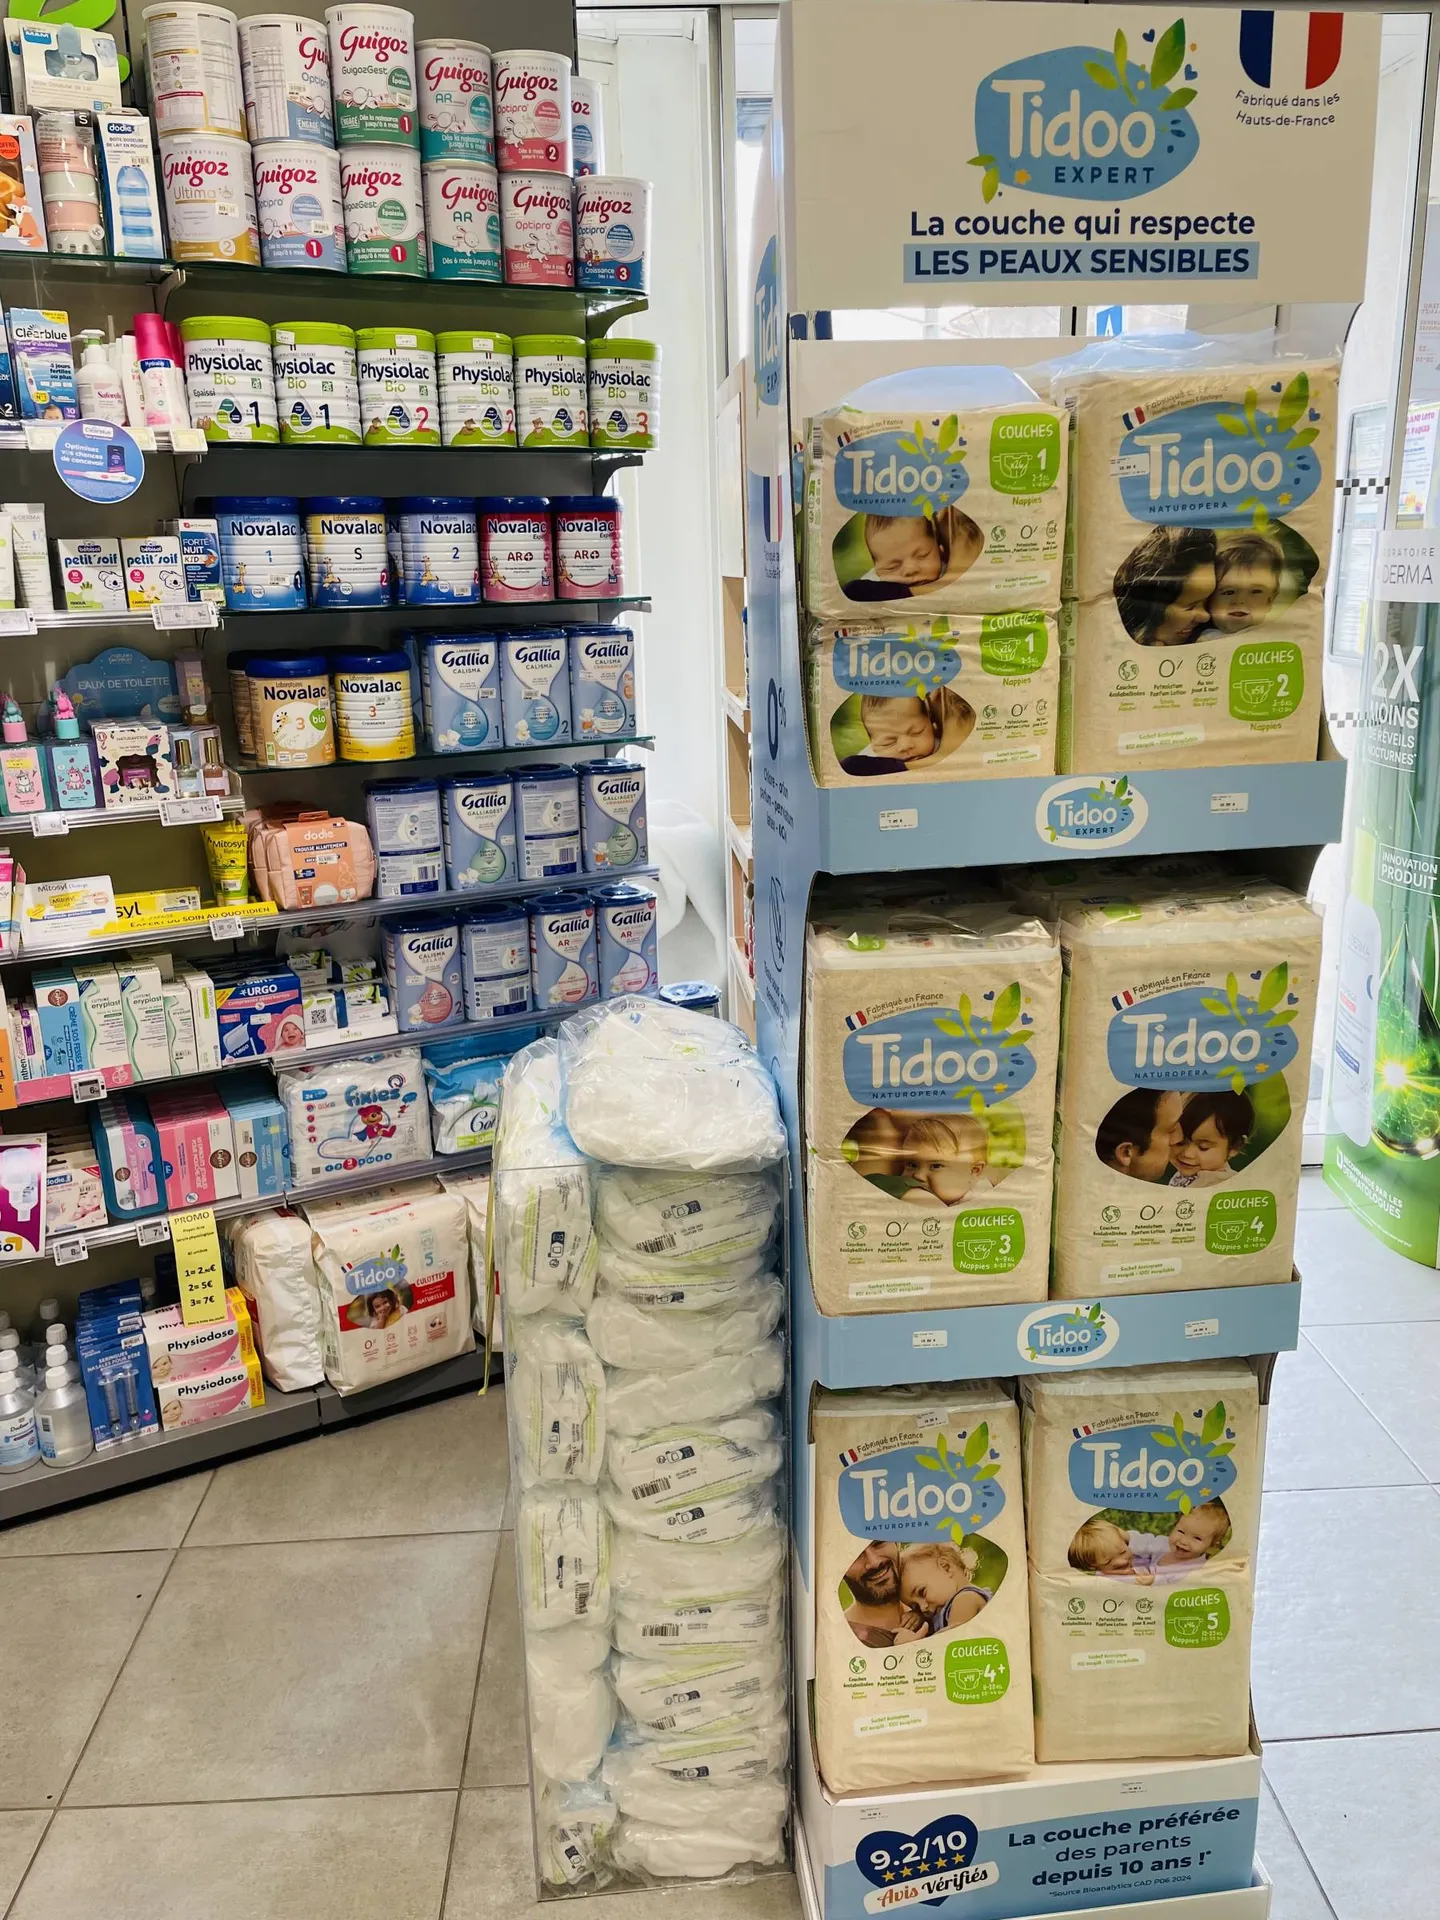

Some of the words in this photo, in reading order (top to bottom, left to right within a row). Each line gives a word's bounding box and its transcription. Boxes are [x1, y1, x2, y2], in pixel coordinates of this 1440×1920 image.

[340, 26, 408, 62] Guigoz
[342, 66, 387, 77] GuigozGest
[425, 57, 488, 92] Guigoz
[496, 71, 558, 100] Guigoz
[435, 93, 452, 103] AR
[1235, 89, 1289, 108] Fabriqué
[1291, 95, 1320, 107] dans
[1322, 93, 1341, 105] les
[992, 79, 1156, 159] Tidoo
[1236, 110, 1336, 127] Hauts-de-France
[109, 124, 131, 132] dodie
[163, 153, 229, 186] Guigoz
[254, 162, 318, 194] Guigoz
[1054, 166, 1156, 185] EXPERT
[174, 187, 216, 200] Ultima
[514, 187, 570, 218] Guigoz
[576, 193, 632, 222] Guigoz
[453, 211, 473, 222] AR
[910, 210, 945, 236] La
[953, 208, 1066, 237] couche
[1074, 208, 1121, 242] qui
[1130, 212, 1256, 242] respecte
[516, 221, 553, 231] Optipro
[914, 249, 971, 275] LES
[980, 249, 1083, 275] PEAUX
[1090, 247, 1251, 274] SENSIBLES
[15, 326, 68, 341] Clearblue
[189, 353, 263, 375] Physiolac
[361, 362, 429, 382] Physiolac
[214, 372, 236, 386] Bio
[287, 377, 307, 389] Bio
[452, 366, 514, 385] Physiolac
[525, 368, 586, 386] Physiolac
[590, 370, 651, 387] Physiolac
[385, 380, 406, 393] Bio
[480, 384, 499, 396] Bio
[552, 385, 570, 397] Bio
[608, 387, 627, 399] Bio
[999, 424, 1054, 439] COUCHES
[65, 442, 99, 452] Optimisez
[75, 450, 103, 460] chances
[71, 457, 105, 466] concevoir
[1037, 448, 1047, 471] 1
[1133, 432, 1284, 500] Tidoo
[843, 450, 943, 496] Tidoo
[1148, 501, 1229, 514] NATUROPERA
[231, 521, 297, 537] Novalac
[321, 519, 383, 535] Novalac
[420, 519, 478, 534] Novalac
[487, 519, 547, 534] Novalac
[557, 518, 614, 533] Novalac
[183, 546, 204, 554] NUIT
[353, 547, 363, 560] S
[989, 612, 1038, 632] COUCHES
[584, 642, 629, 659] Gallia
[1024, 632, 1035, 654] 1
[441, 650, 490, 668] Gallia
[515, 646, 561, 664] Gallia
[845, 636, 936, 678] Tidoo
[1239, 650, 1295, 666] COUCHES
[525, 662, 553, 670] CALISMA
[1371, 641, 1424, 703] 2X
[78, 681, 103, 690] EAUX
[108, 680, 121, 689] DE
[125, 677, 170, 688] TOILETTE
[340, 678, 402, 693] Novalac
[1002, 676, 1032, 687] Nappies
[1276, 673, 1290, 697] 2
[263, 685, 327, 701] Novalac
[312, 713, 326, 724] bio
[1371, 702, 1420, 730] MOINS
[1377, 728, 1416, 749] RÉVEILS
[597, 780, 640, 795] Gallia
[461, 794, 507, 810] Gallia
[1053, 799, 1118, 827] Tidoo
[304, 829, 334, 840] dodie
[1075, 826, 1115, 836] EXPERT
[212, 838, 245, 849] Mitosyl
[1382, 851, 1439, 876] INNOVATION
[1380, 862, 1438, 891] PRODUIT
[37, 883, 68, 893] Mitosyl
[182, 914, 203, 922] SOIN
[220, 906, 270, 918] QUOTIDIEN
[611, 911, 652, 927] Gallia
[548, 917, 590, 934] Gallia
[407, 936, 453, 953] Gallia
[247, 984, 278, 997] URGO
[1132, 975, 1168, 995] Fabriqué
[1170, 974, 1182, 983] en
[1182, 970, 1212, 981] France
[866, 997, 902, 1016] Fabriqué
[904, 996, 914, 1004] en
[915, 993, 944, 1002] France
[1121, 1012, 1261, 1068] Tidoo
[856, 1034, 998, 1089] Tidoo
[1134, 1068, 1209, 1080] NATUROPERA
[872, 1089, 947, 1100] NATUROPERA
[1216, 1196, 1269, 1210] COUCHES
[174, 1211, 210, 1225] PROMO
[961, 1215, 1016, 1229] COUCHES
[1250, 1215, 1264, 1235] 4
[999, 1234, 1011, 1255] 3
[1211, 1242, 1242, 1251] Nappies
[959, 1260, 991, 1271] Nappies
[201, 1280, 213, 1290] 5€
[349, 1266, 396, 1289] Tidoo
[416, 1271, 446, 1286] CULOTTES
[203, 1295, 216, 1305] 7€
[167, 1327, 235, 1352] Physiodose
[1032, 1324, 1092, 1348] Tidoo
[1053, 1346, 1089, 1354] EXPERT
[177, 1372, 245, 1396] Physiodose
[1091, 1414, 1124, 1430] Fabriqué
[1135, 1410, 1160, 1419] France
[857, 1436, 888, 1454] Fabriqué
[1081, 1442, 1204, 1490] Tidoo
[849, 1469, 972, 1522] Tidoo
[1092, 1490, 1159, 1499] NATUROPERA
[865, 1521, 930, 1531] NATUROPERA
[1173, 1593, 1221, 1608] COUCHES
[1206, 1612, 1219, 1630] 5
[951, 1644, 1000, 1658] COUCHES
[1008, 1830, 1036, 1848] La
[1043, 1821, 1132, 1844] couche
[1138, 1806, 1240, 1839] préférée
[869, 1830, 968, 1871] 9.2/10
[1055, 1847, 1096, 1863] des
[1103, 1833, 1192, 1860] parents
[1032, 1863, 1113, 1886] depuis
[1119, 1859, 1144, 1876] 10
[1150, 1856, 1192, 1871] ans
[876, 1885, 919, 1908] Avis
[921, 1867, 988, 1895] Vérifiés
[1082, 1882, 1132, 1894] Bioanalytics
[1133, 1879, 1152, 1888] CAD
[1154, 1877, 1170, 1885] P06
[1171, 1874, 1192, 1882] 2024
